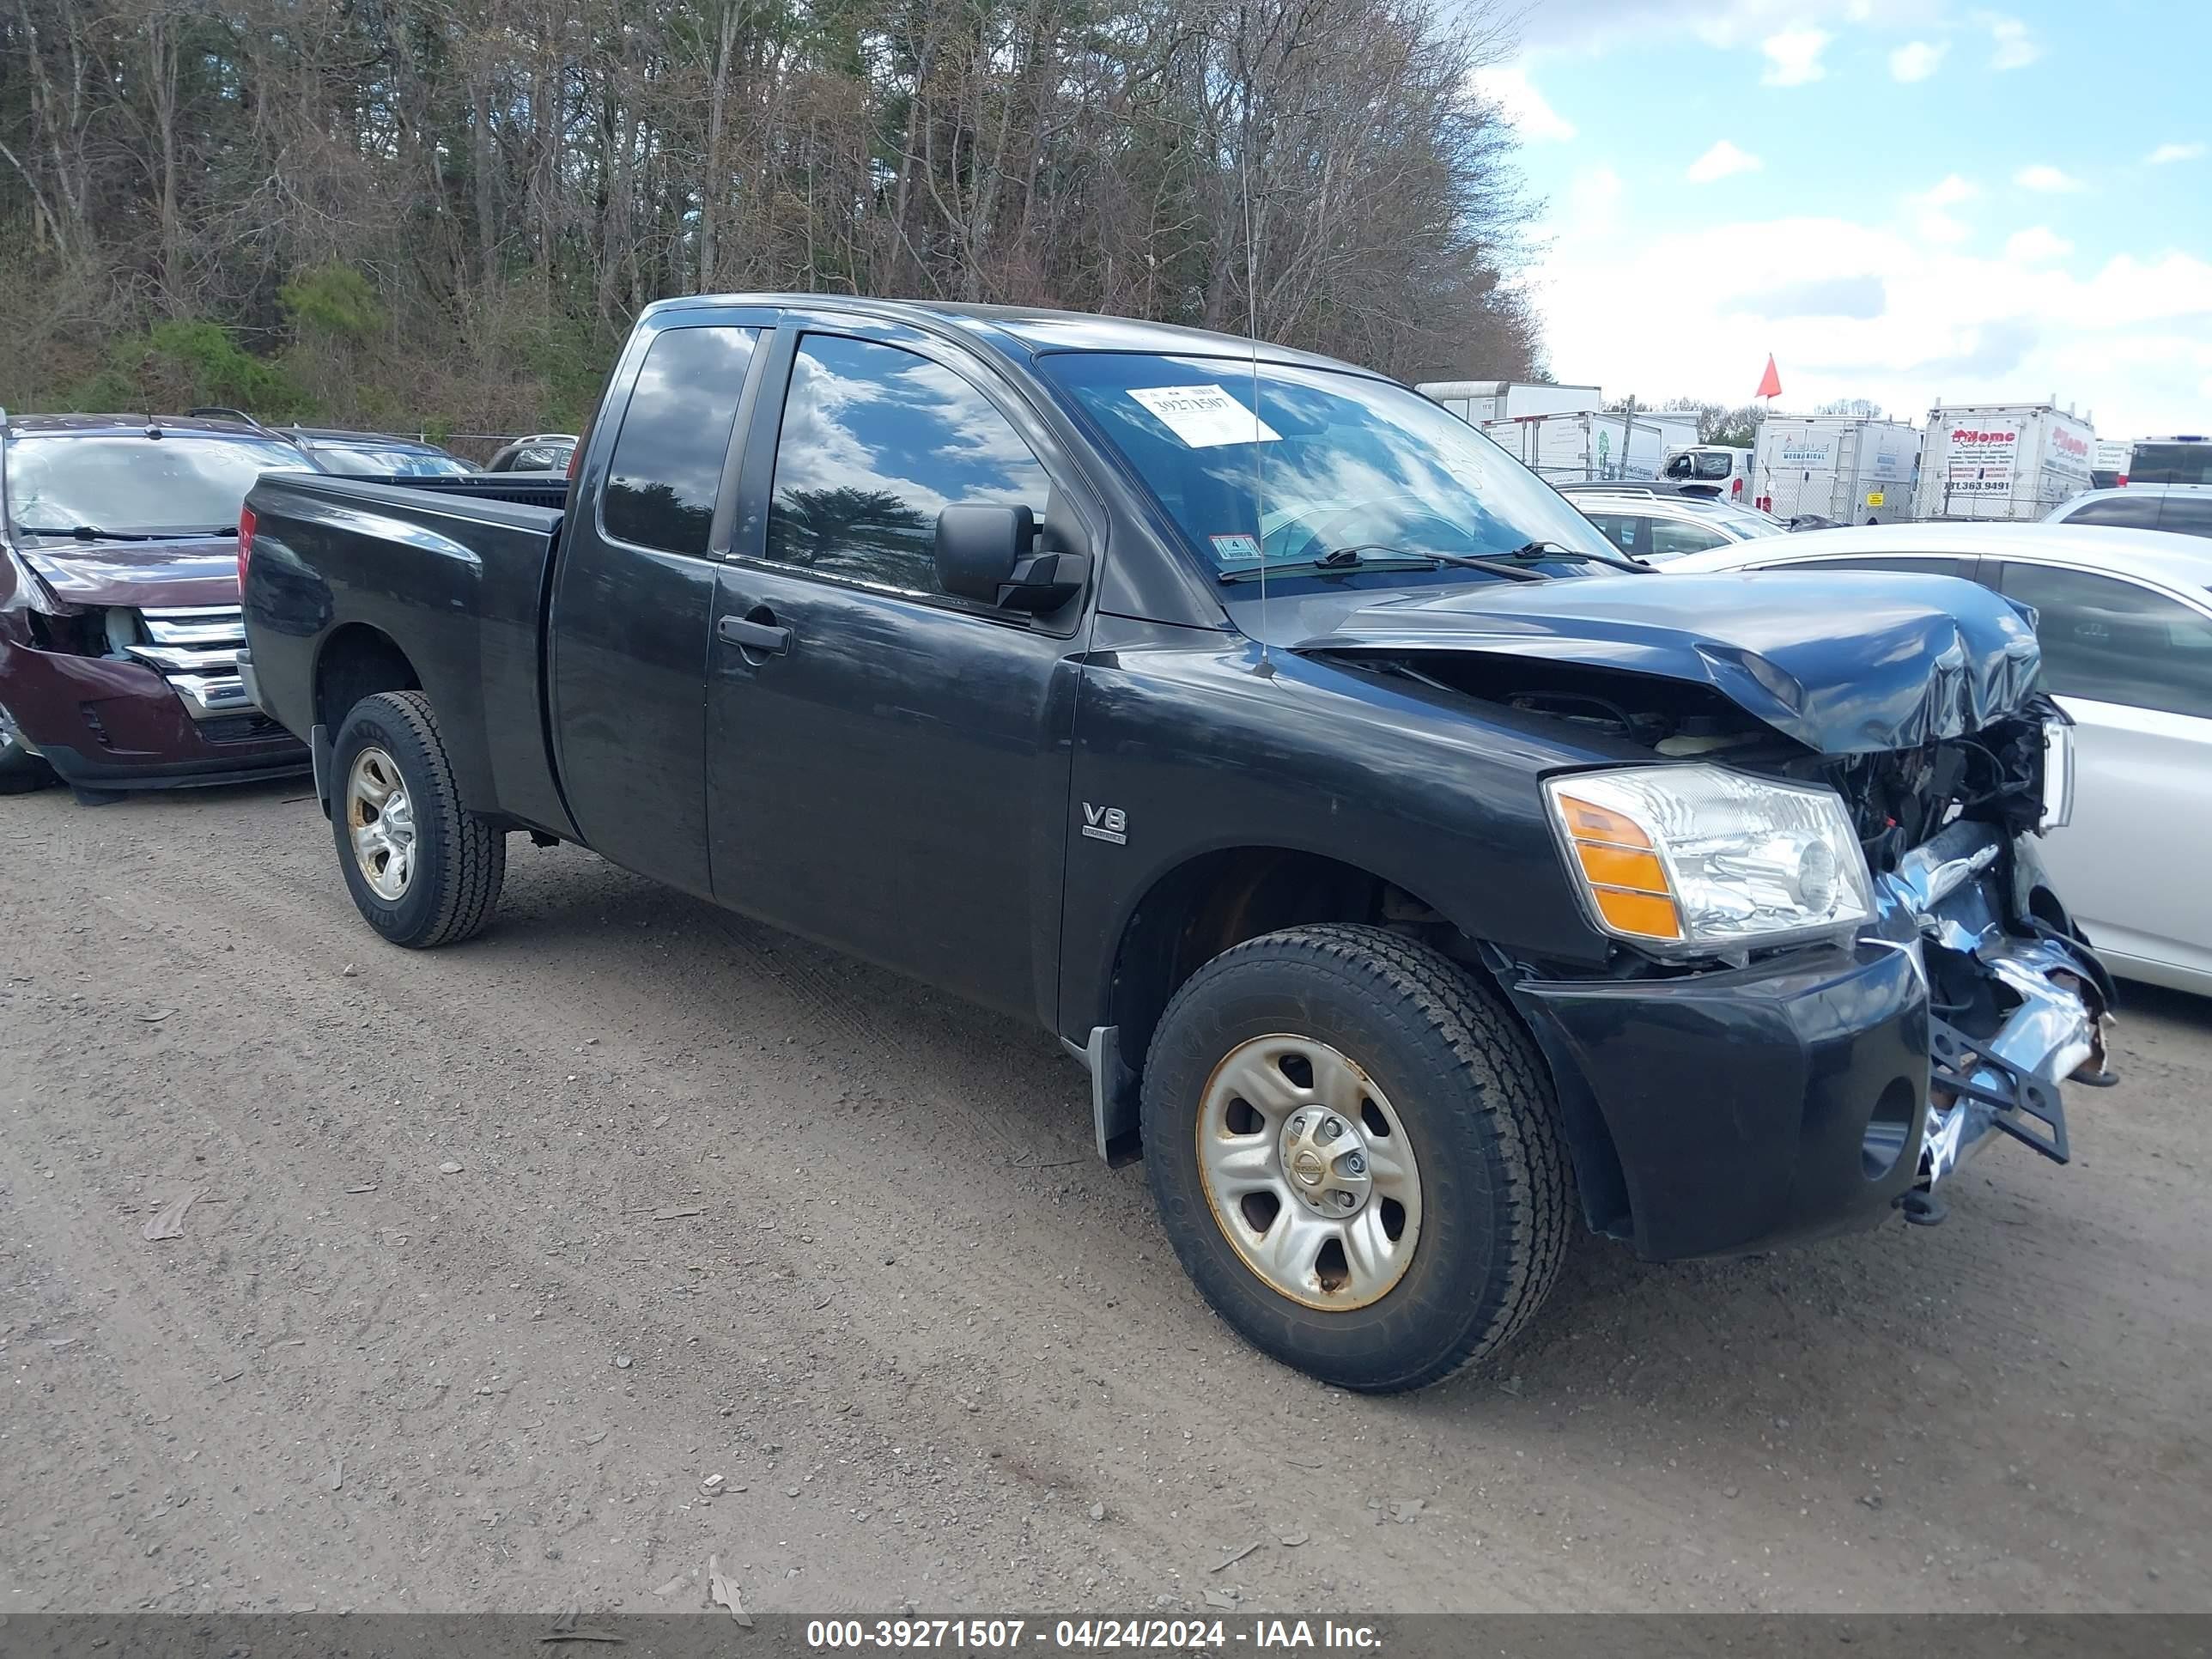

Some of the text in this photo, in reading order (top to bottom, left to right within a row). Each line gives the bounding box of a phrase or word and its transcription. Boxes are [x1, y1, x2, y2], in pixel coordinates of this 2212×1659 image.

[1153, 398, 1229, 412] 39271507
[1966, 430, 2015, 442] Home
[1959, 440, 2014, 449] Solution
[1082, 802, 1126, 832] V8
